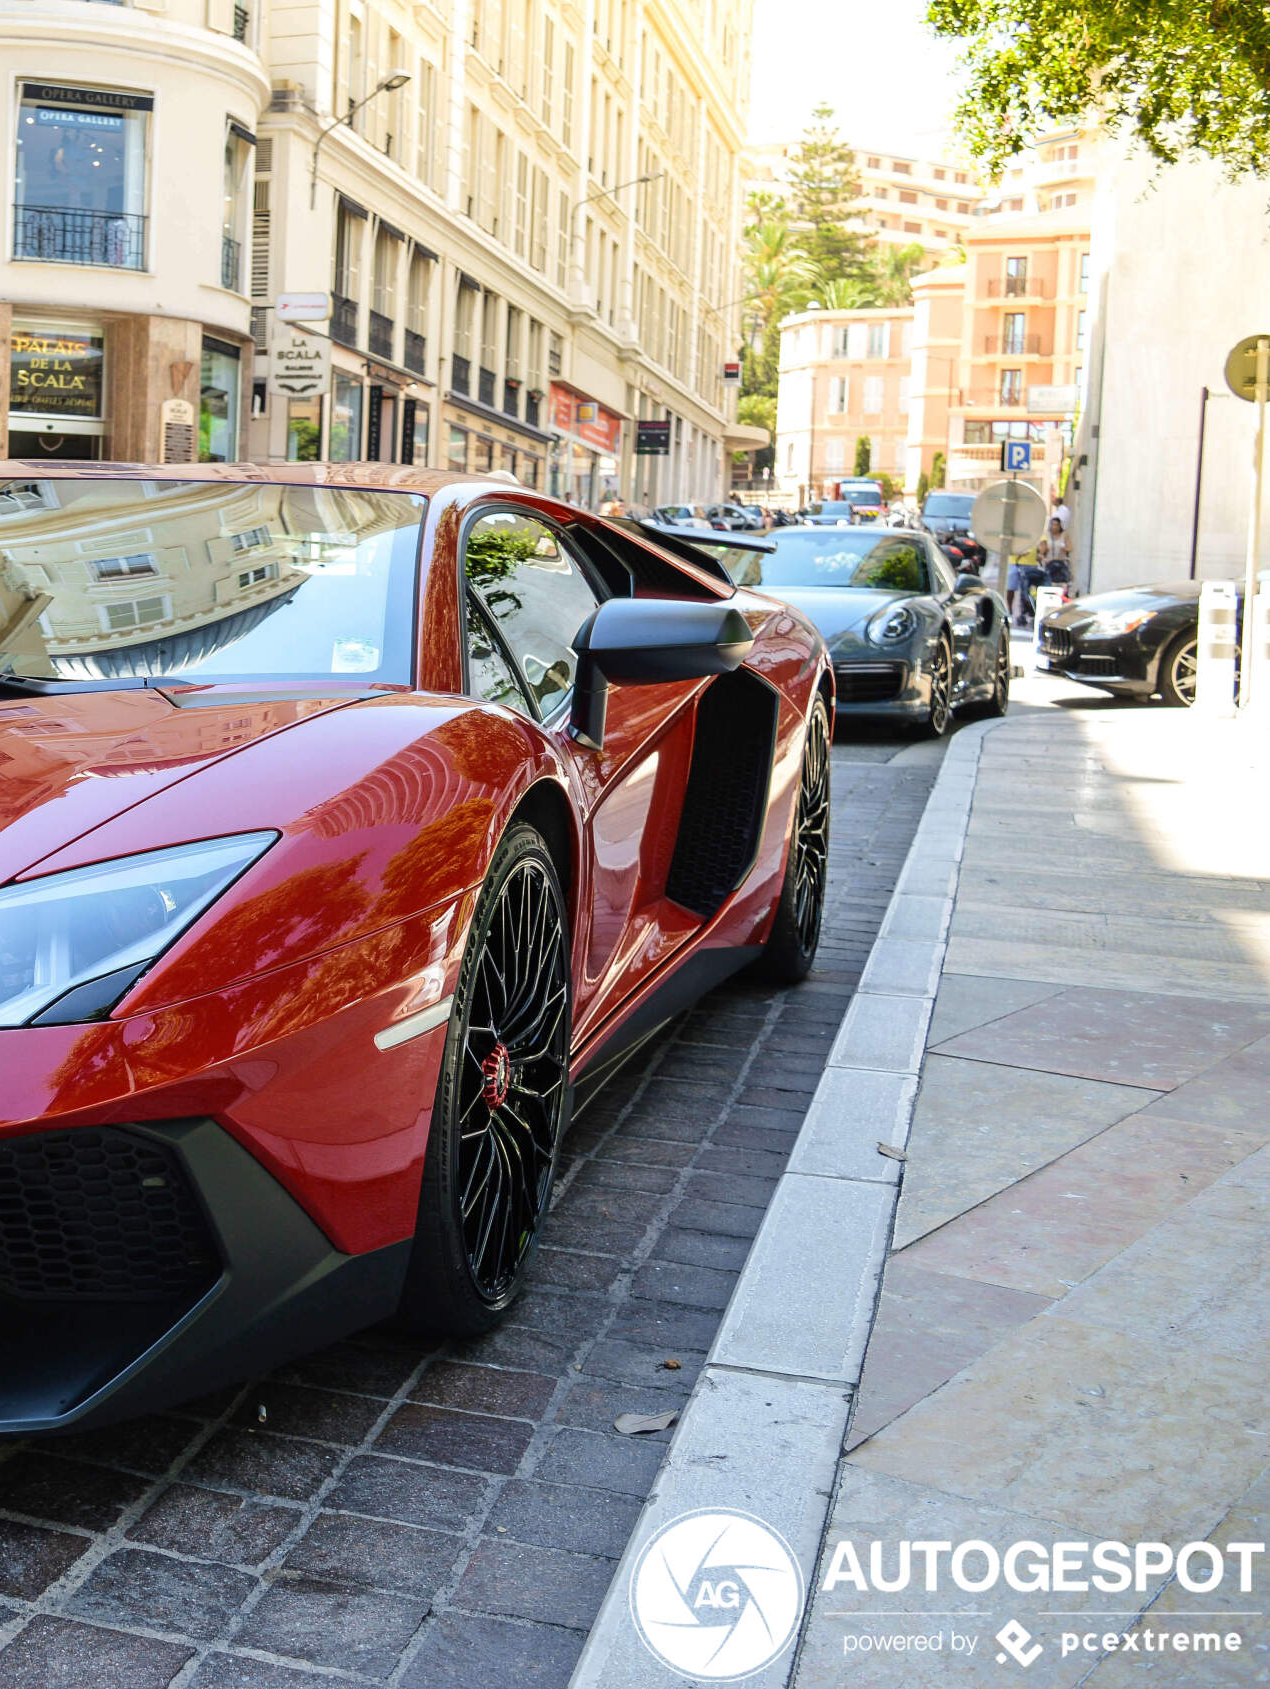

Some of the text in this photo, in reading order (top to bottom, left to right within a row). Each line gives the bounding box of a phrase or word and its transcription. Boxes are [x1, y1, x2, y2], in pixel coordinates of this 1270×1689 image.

[42, 88, 137, 107] OPERA GALLERY
[40, 111, 121, 126] OPERA GALLERY
[16, 339, 86, 356] PALAIS
[292, 339, 307, 347] LA
[277, 351, 322, 360] SCALA
[31, 358, 72, 371] DE LA
[17, 369, 84, 390] SCALA
[1012, 446, 1025, 467] P
